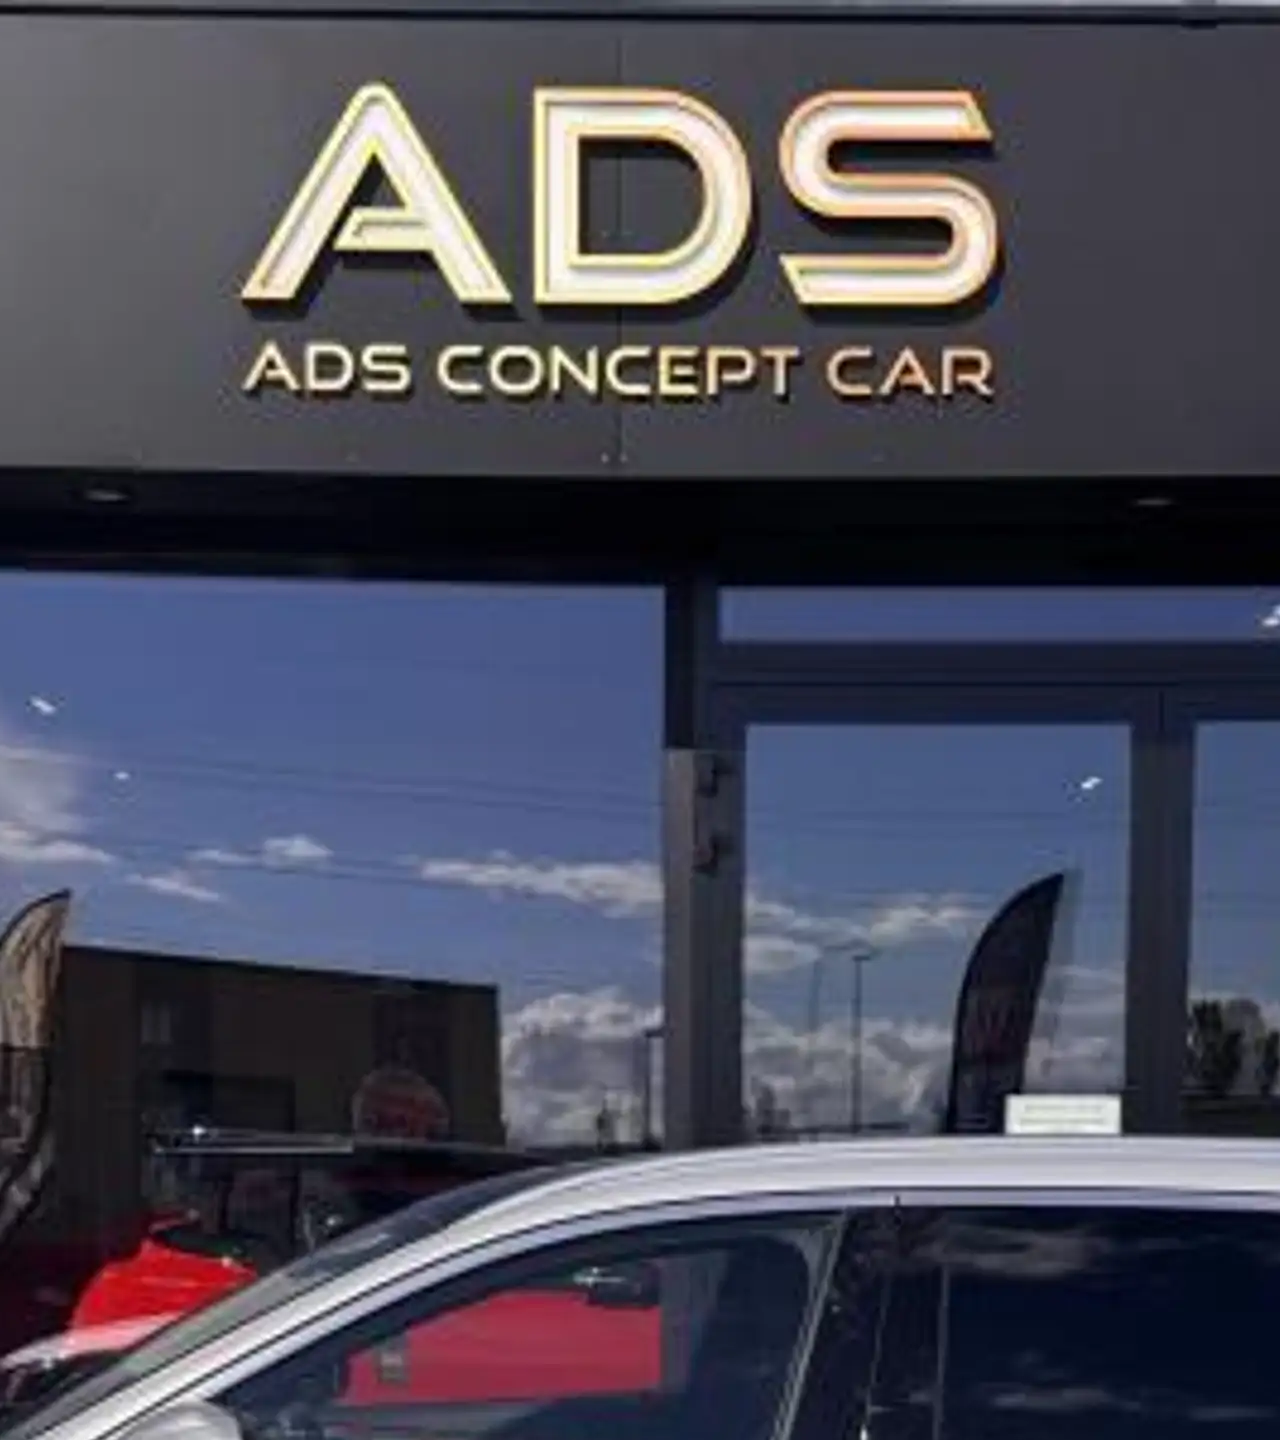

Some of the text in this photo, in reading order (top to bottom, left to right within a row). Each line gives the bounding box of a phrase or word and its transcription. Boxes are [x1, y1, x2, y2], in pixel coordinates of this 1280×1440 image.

[241, 81, 998, 306] ADS
[241, 341, 997, 397] ADS CONCEPT CAR
